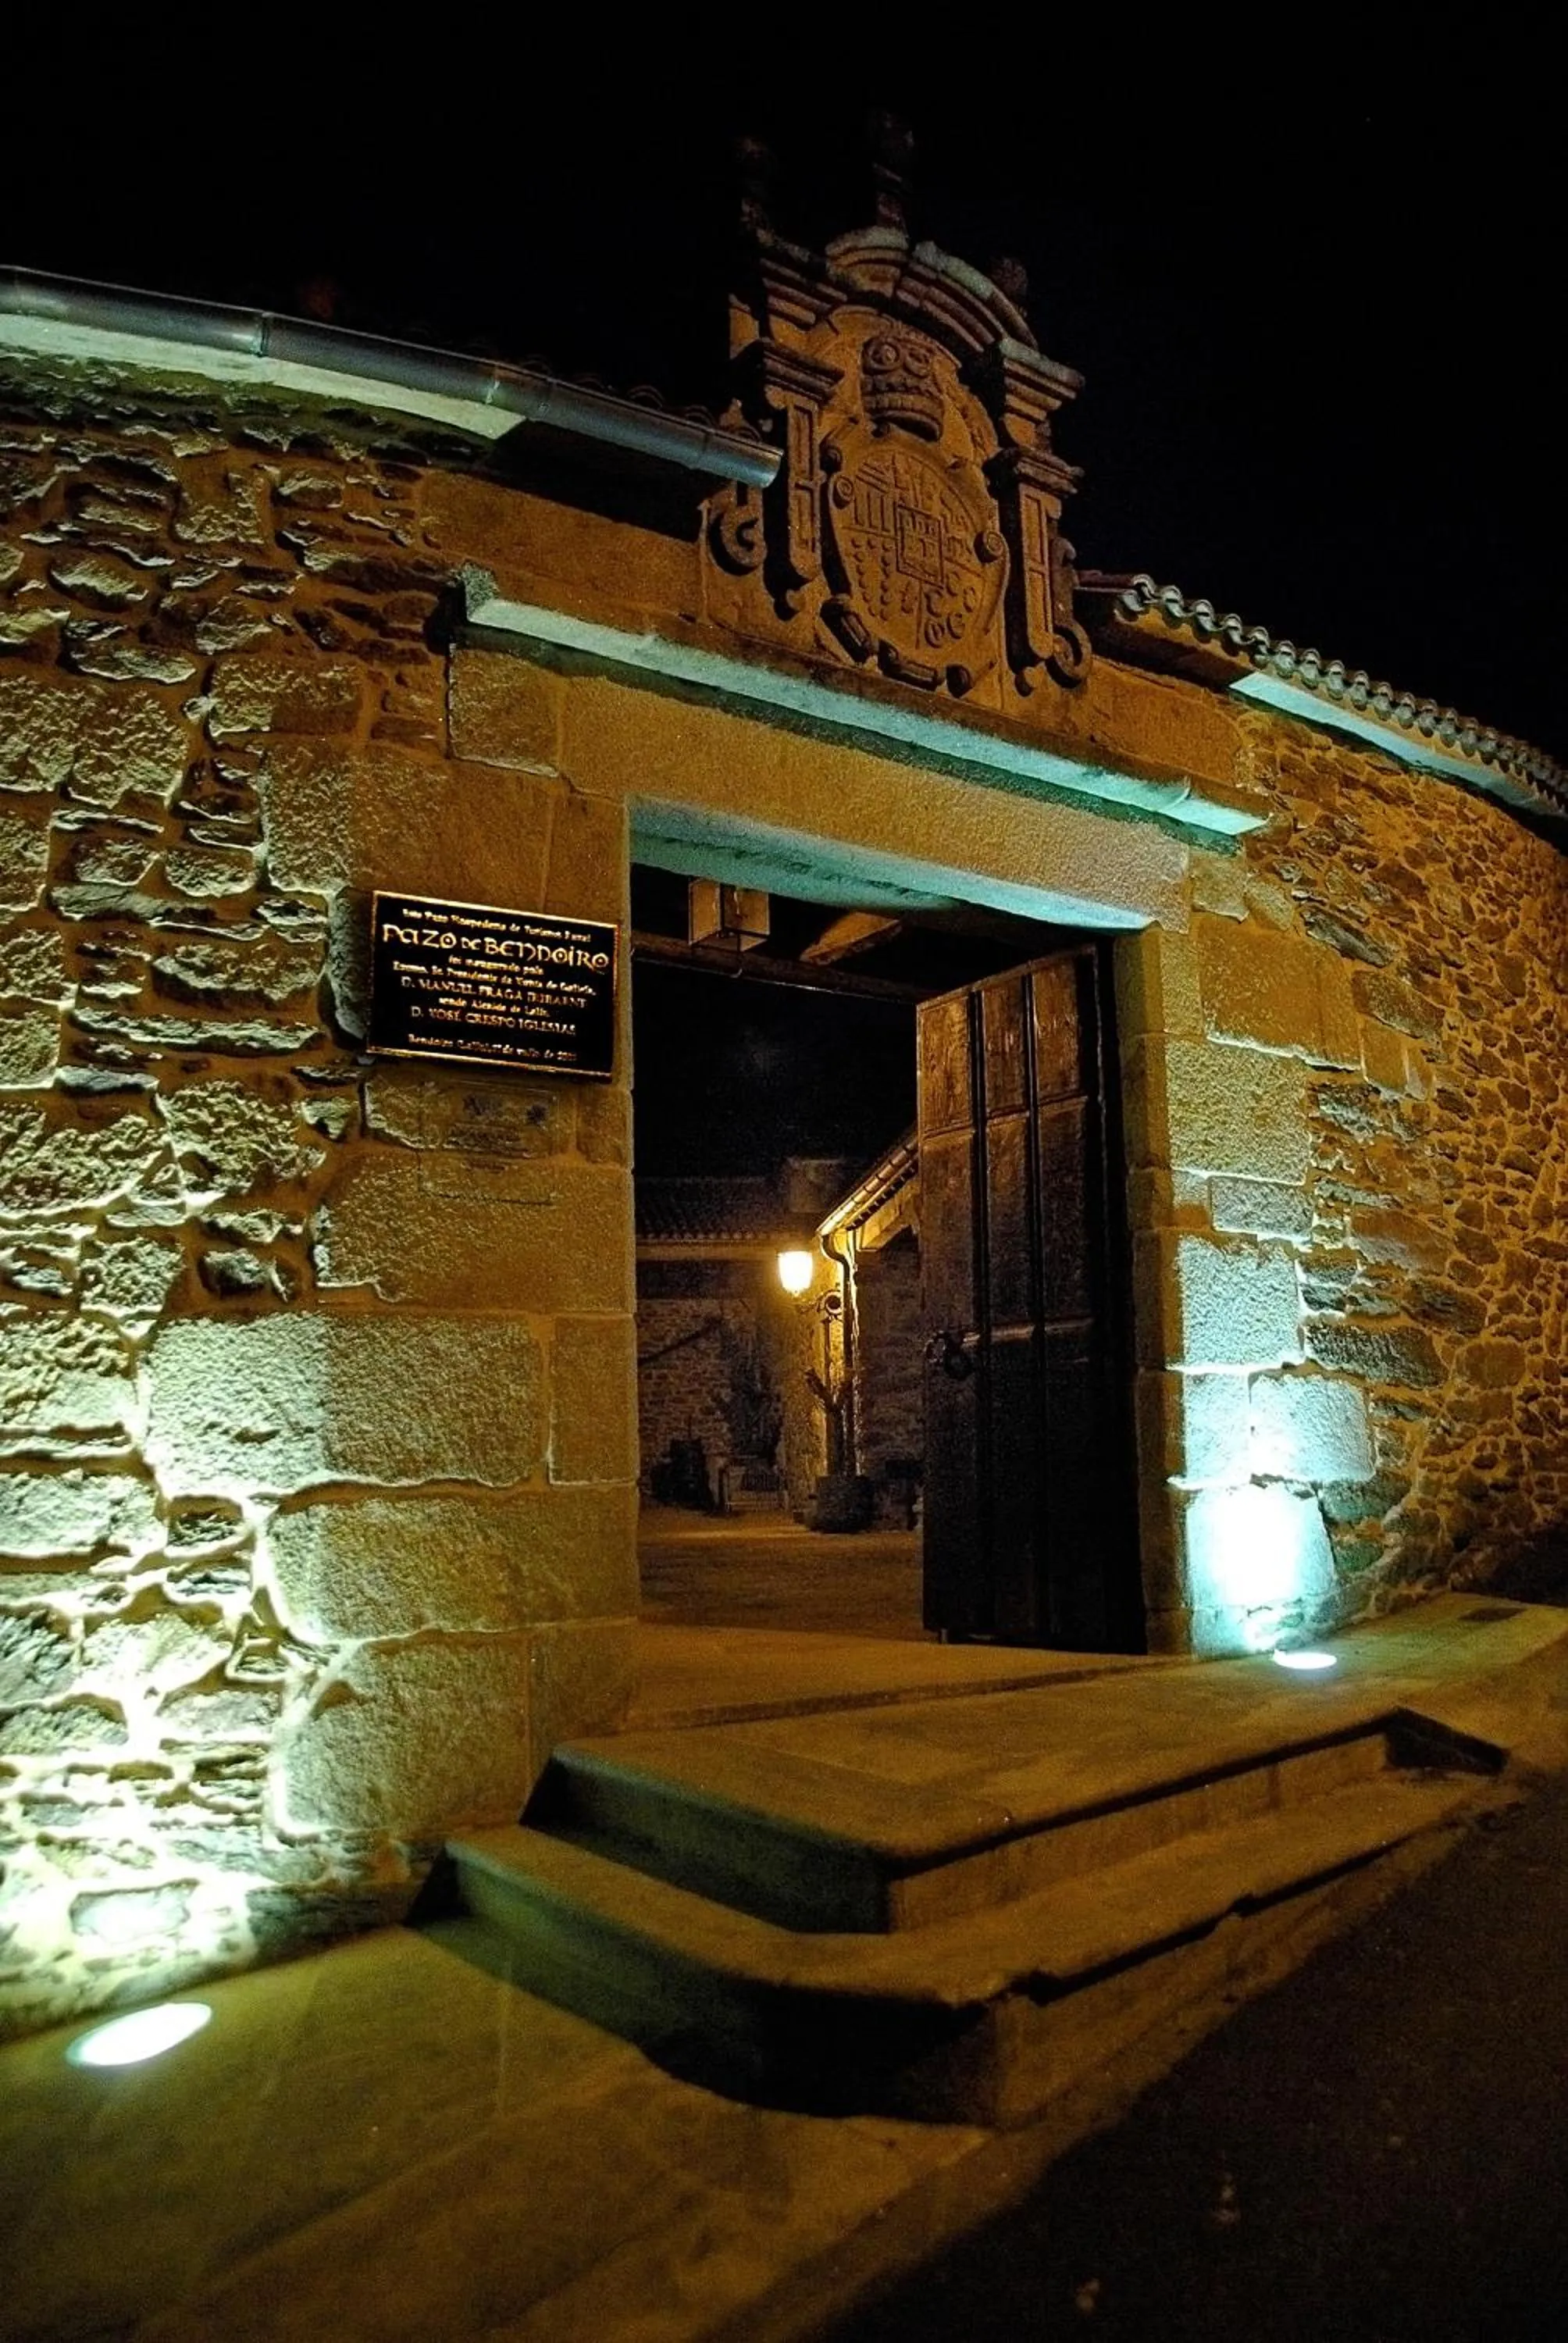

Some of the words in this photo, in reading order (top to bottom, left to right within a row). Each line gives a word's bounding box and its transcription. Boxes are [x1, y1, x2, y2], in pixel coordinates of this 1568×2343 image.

[418, 979, 476, 994] MANUEL
[479, 986, 522, 1000] FRAGA
[465, 1013, 515, 1028] CRESPO
[519, 1018, 576, 1036] IGLESIAS
